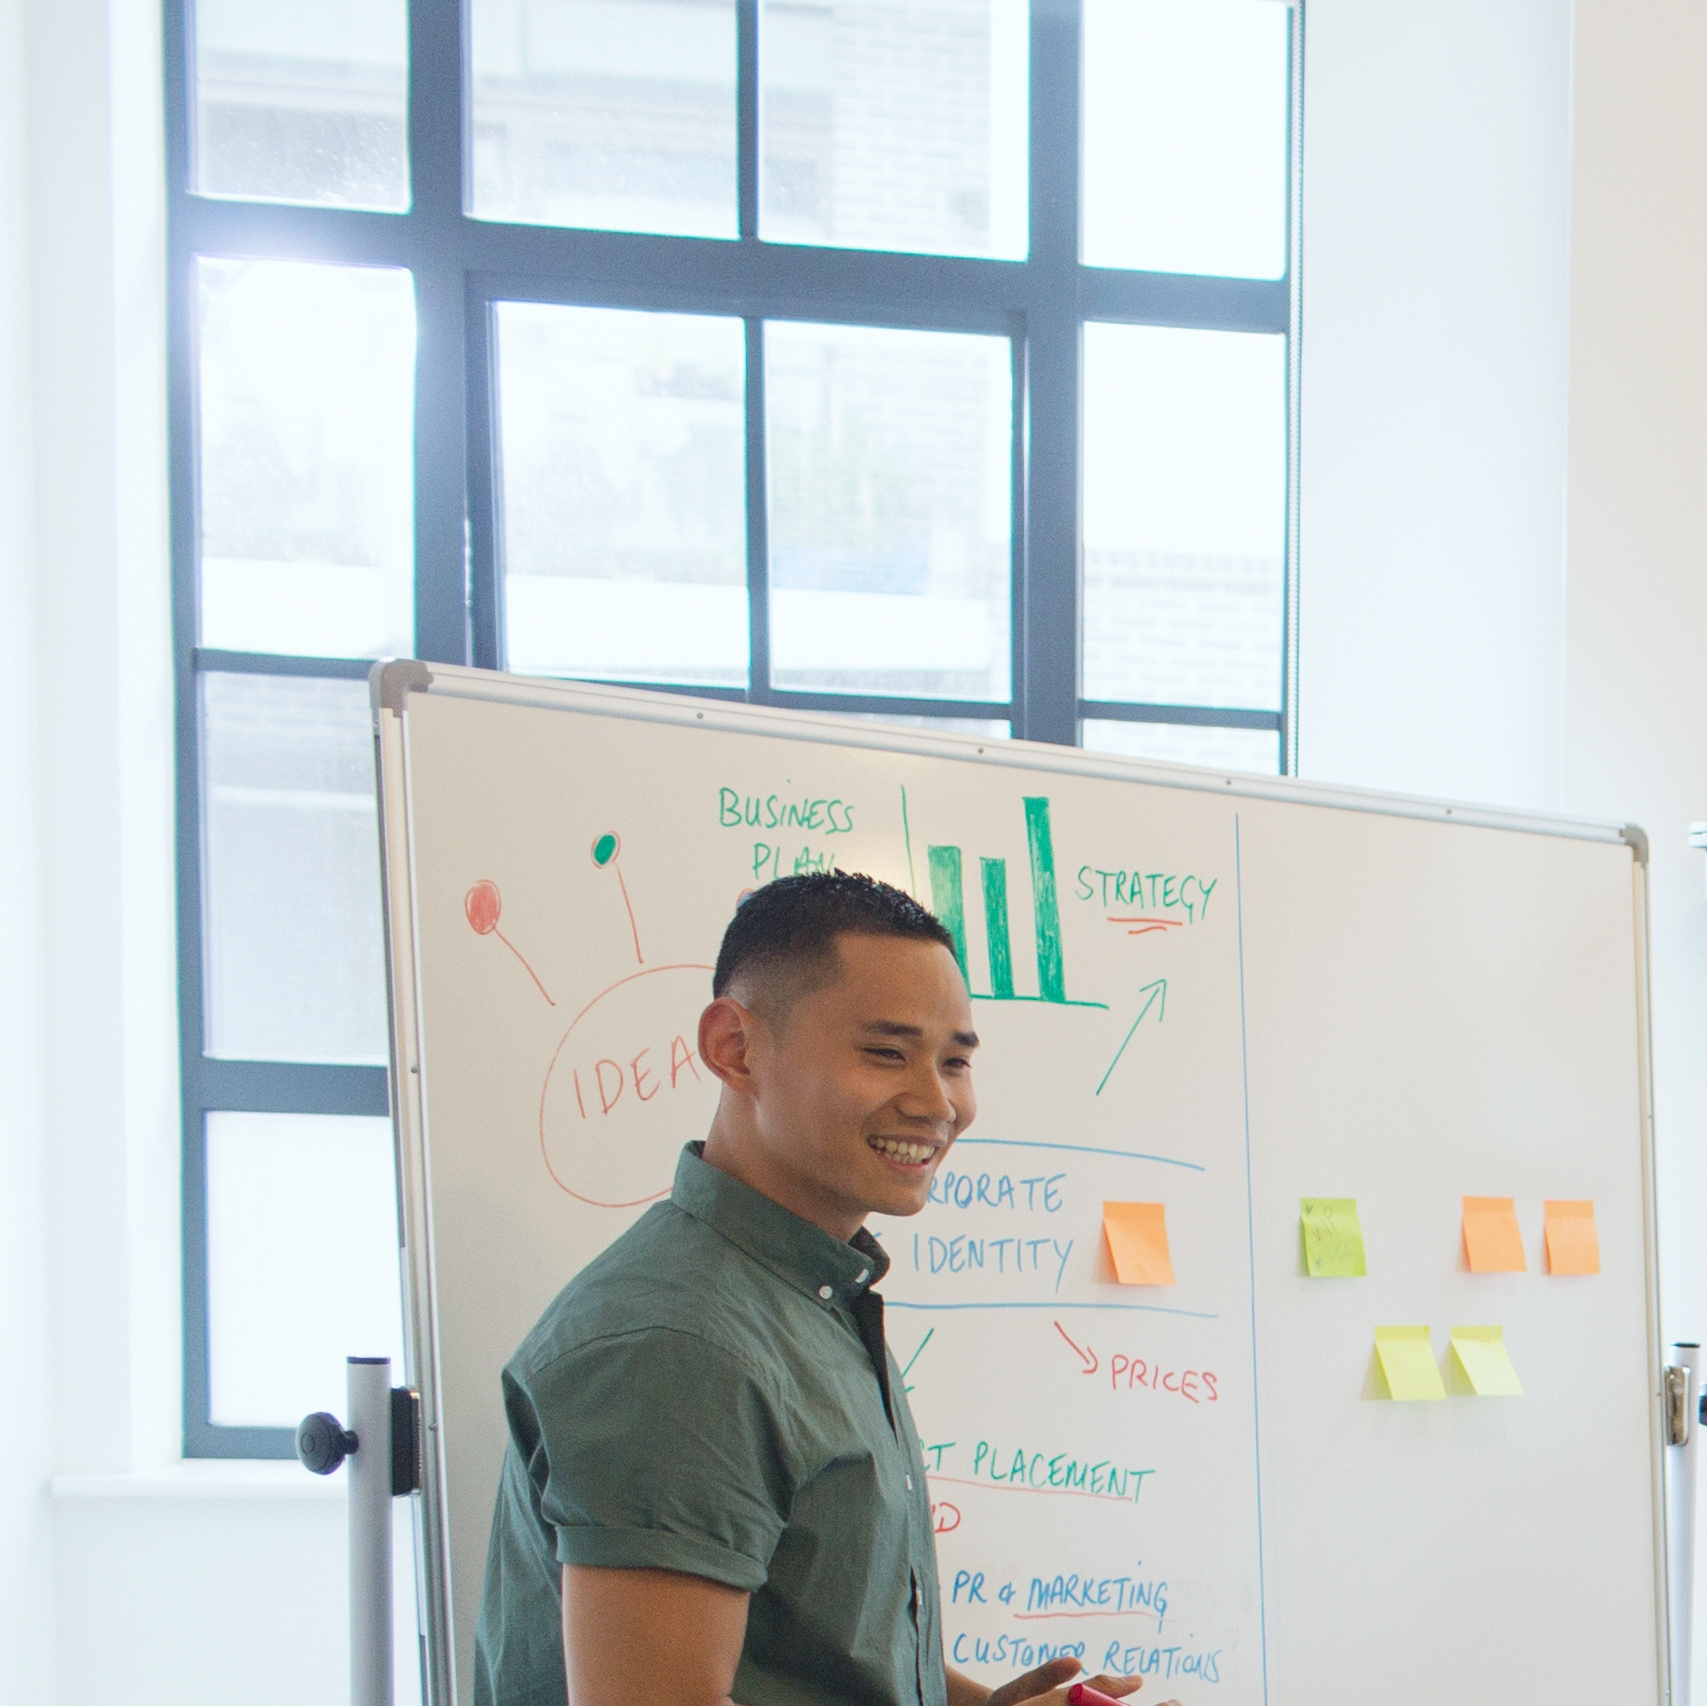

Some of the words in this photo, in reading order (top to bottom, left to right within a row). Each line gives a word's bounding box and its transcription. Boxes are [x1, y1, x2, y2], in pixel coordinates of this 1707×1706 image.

[752, 842, 836, 881] PLAN
[1075, 864, 1218, 925] STRATEGY
[572, 1034, 701, 1119] IDEA
[926, 1170, 1067, 1214] RPORATE
[912, 1232, 1074, 1294] IDENTITY
[1110, 1353, 1219, 1404] PRICES
[973, 1441, 1156, 1503] PLACEMENT
[952, 1569, 987, 1605] PR
